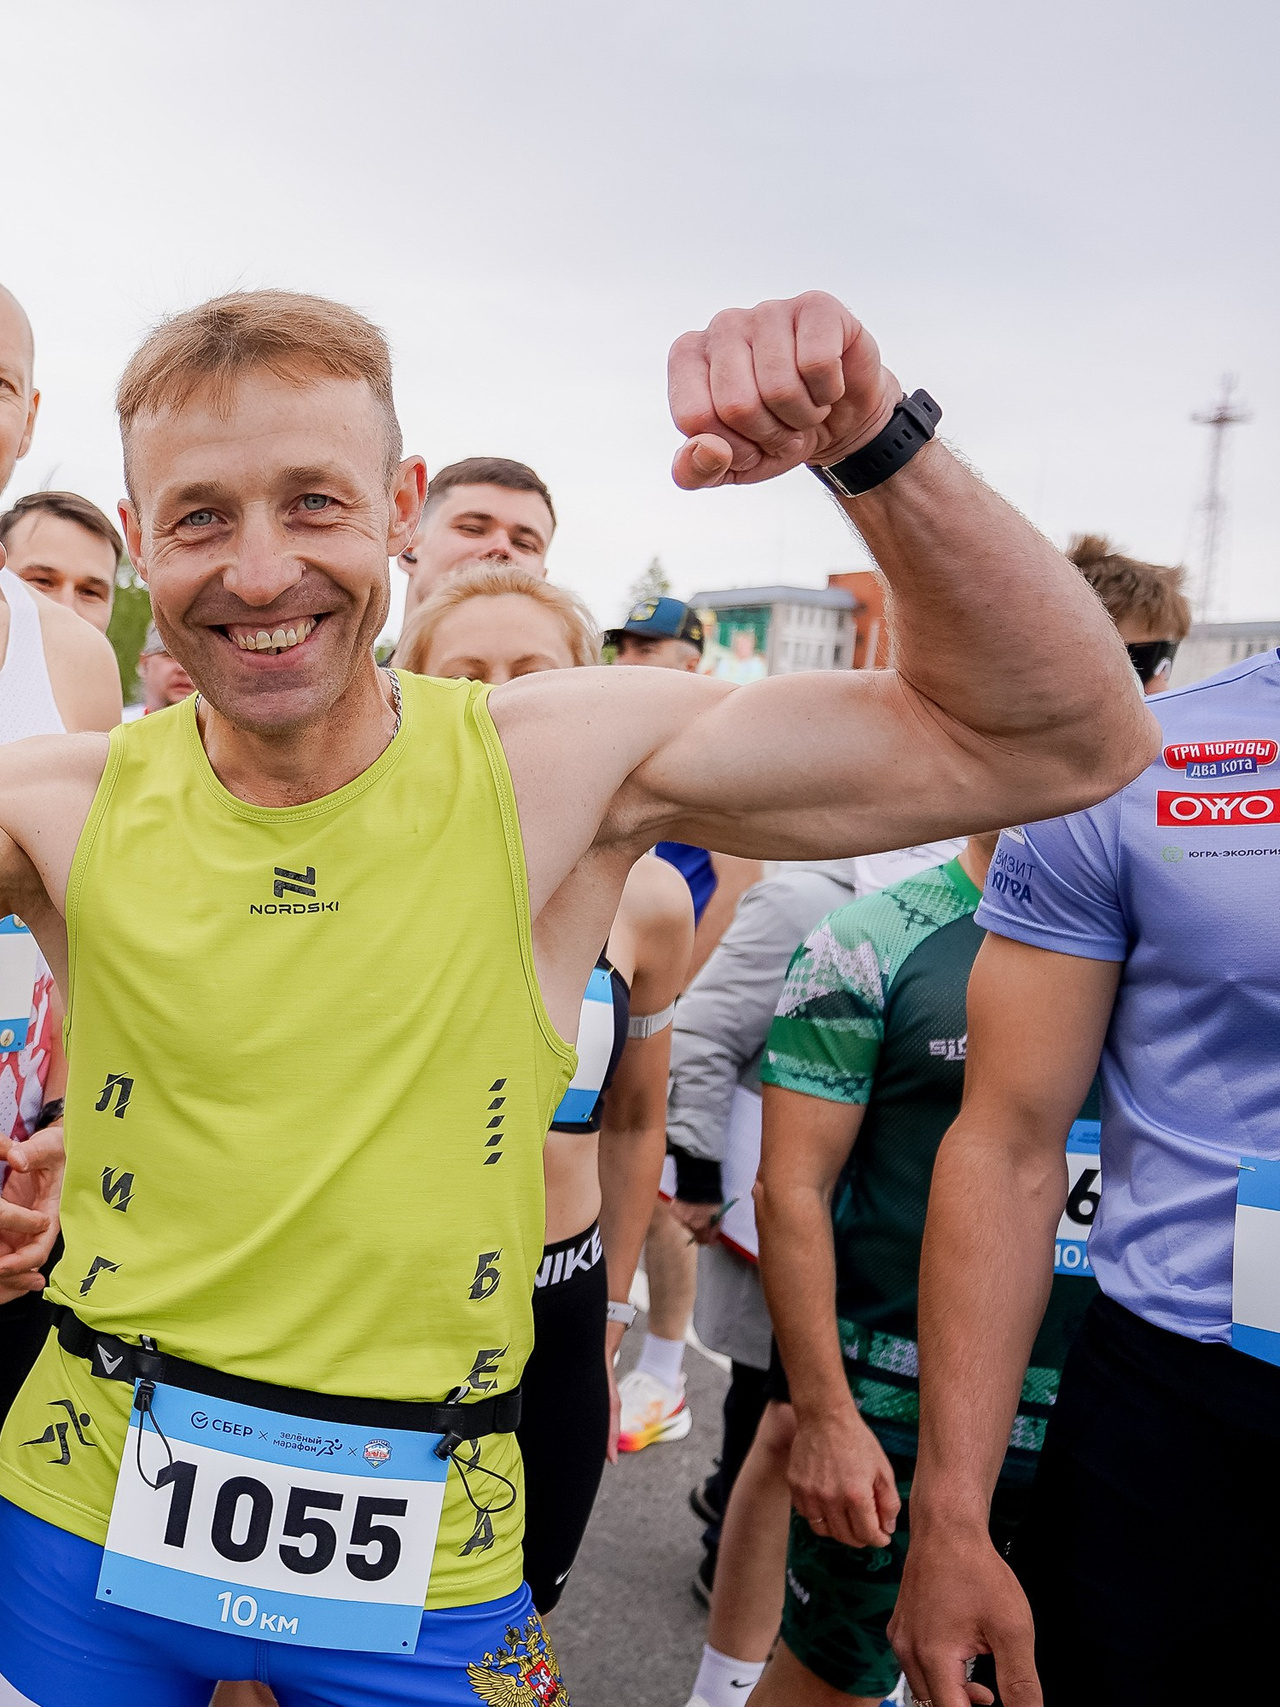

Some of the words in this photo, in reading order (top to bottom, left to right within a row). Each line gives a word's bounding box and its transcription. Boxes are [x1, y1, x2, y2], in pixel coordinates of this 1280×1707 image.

[1171, 744, 1200, 761] ТРИ
[250, 901, 339, 915] NORDSKI
[212, 1419, 253, 1437] СБЕР
[273, 1438, 317, 1453] марафон
[280, 1431, 322, 1445] зелёный
[153, 1460, 409, 1582] 1055
